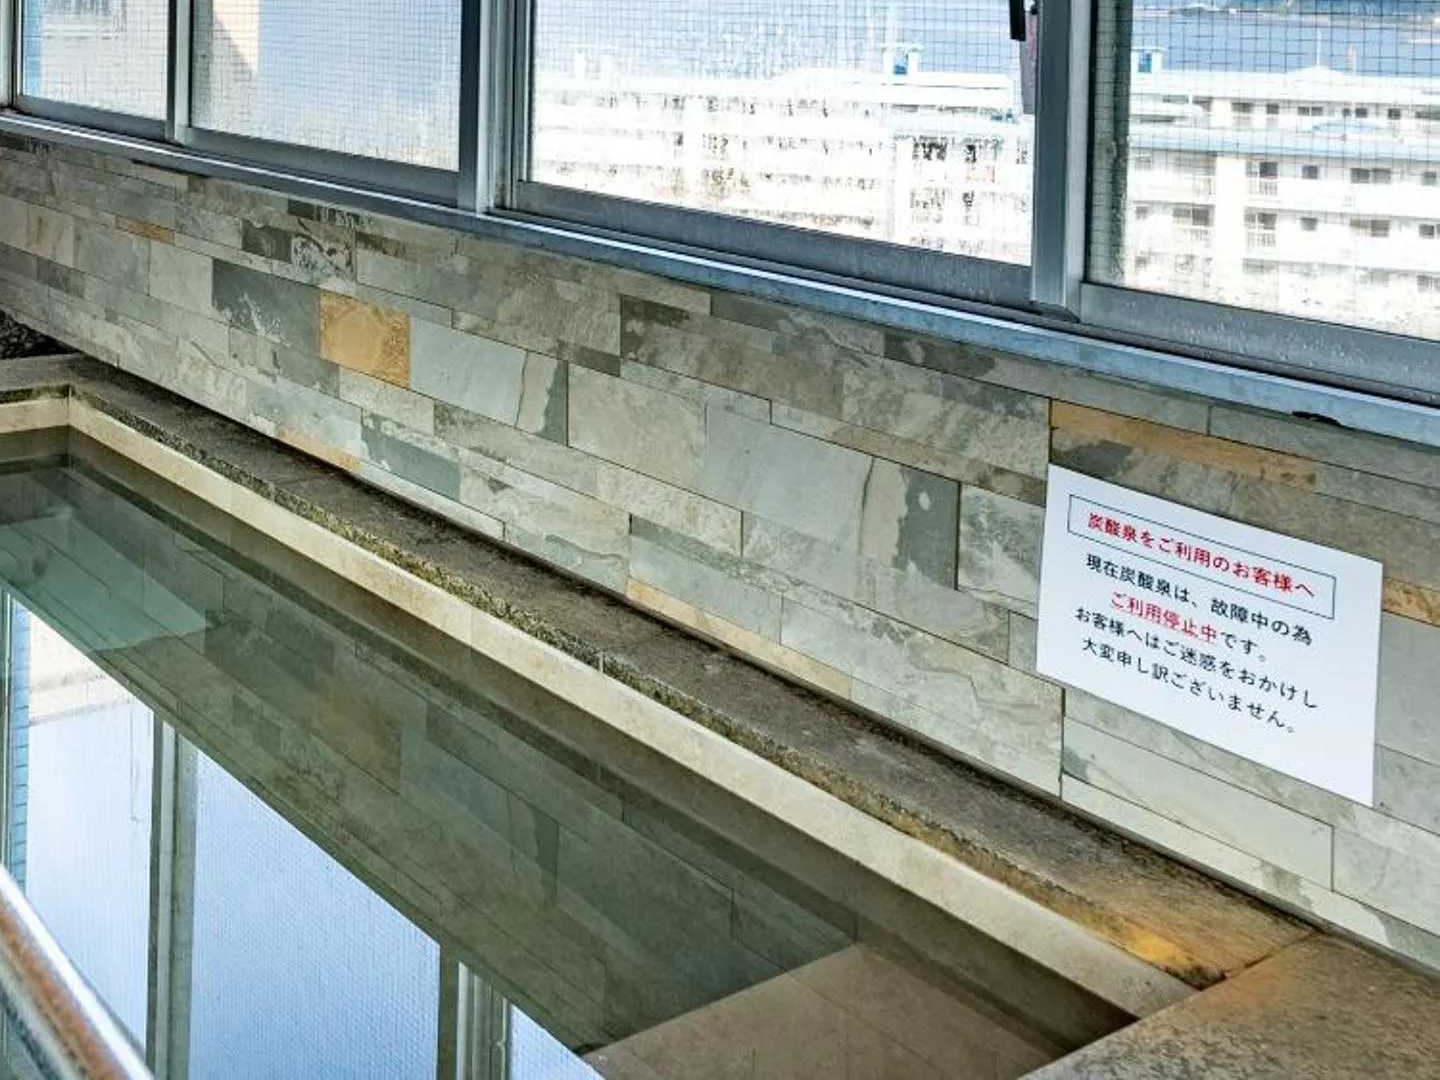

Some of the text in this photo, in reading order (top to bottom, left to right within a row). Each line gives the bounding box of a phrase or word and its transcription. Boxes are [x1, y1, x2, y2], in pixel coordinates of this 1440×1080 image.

[1084, 552, 1313, 647] 現在炭酸泉は、故障中の為
[1087, 511, 1318, 598] 炭酸泉をご利用のお客様へ
[1075, 606, 1318, 710] お客様へはご迷惑をおかけし
[1110, 591, 1268, 663] ご利用停止中です。
[1082, 637, 1296, 734] 大変申し訳ございません。
